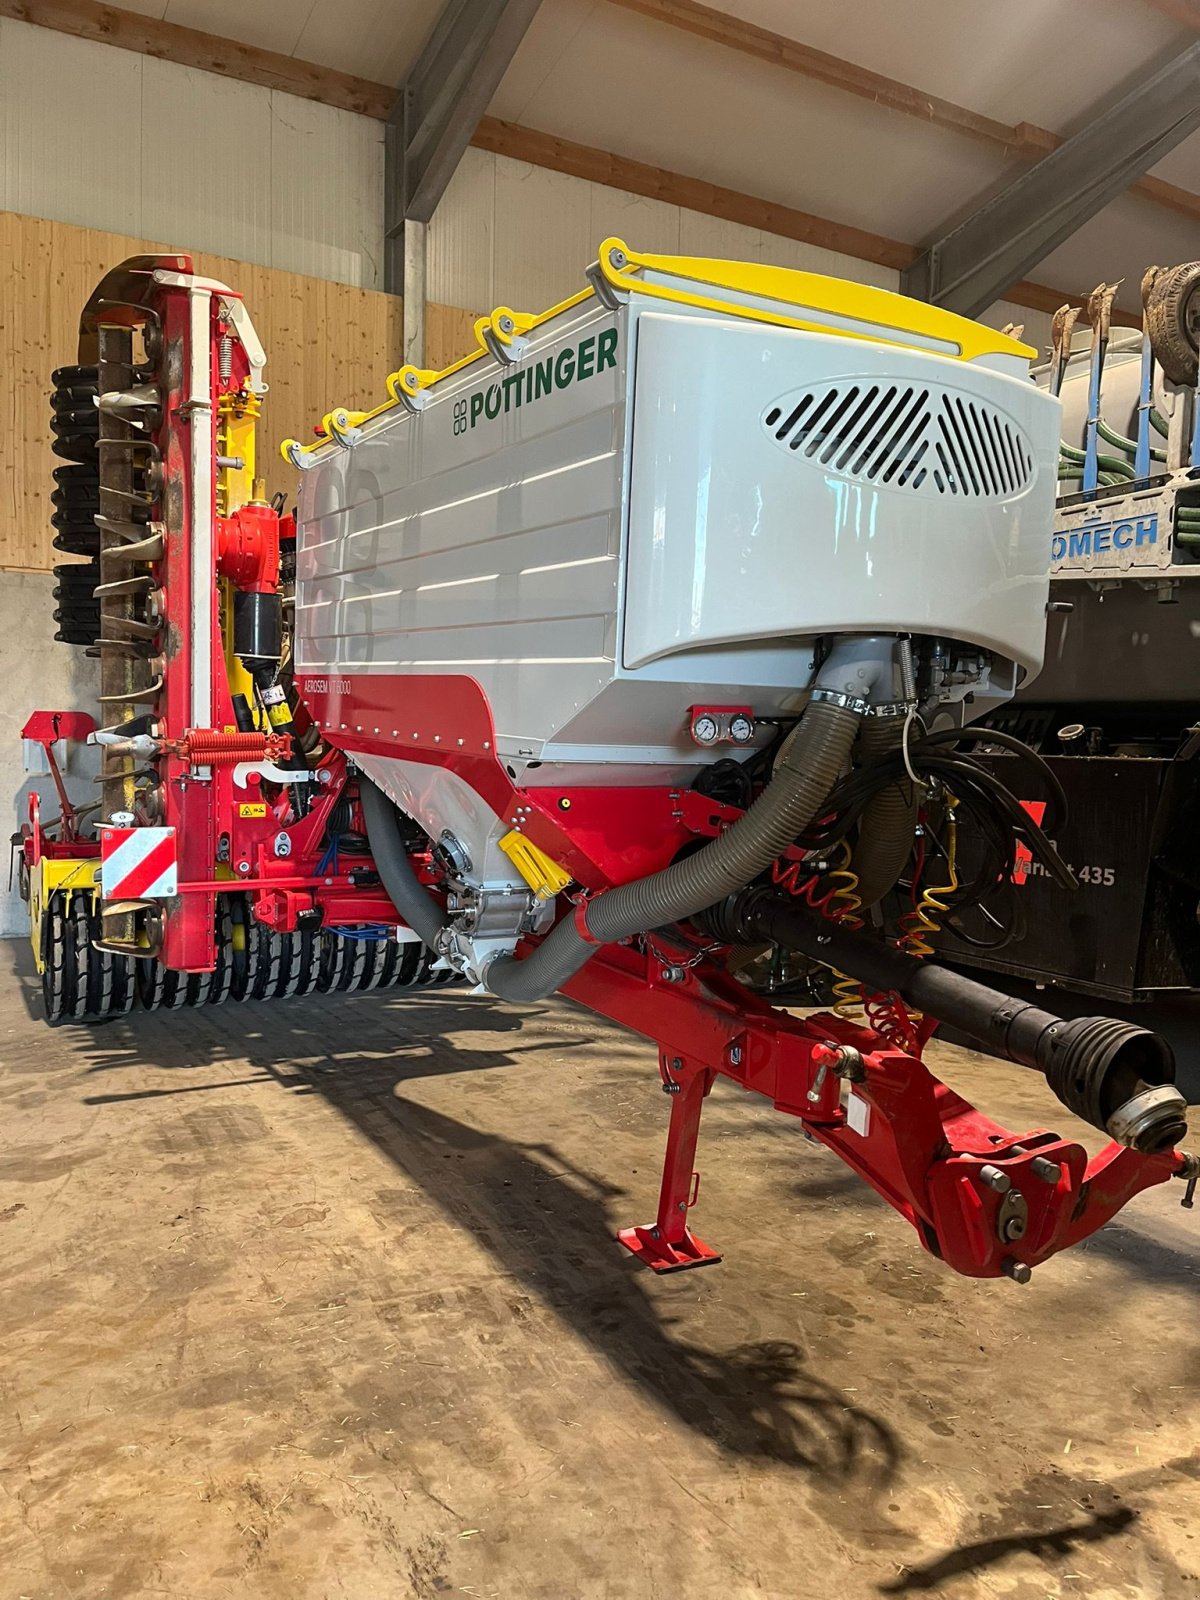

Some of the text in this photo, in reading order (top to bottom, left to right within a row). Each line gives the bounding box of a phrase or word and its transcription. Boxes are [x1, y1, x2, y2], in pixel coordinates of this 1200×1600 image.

[470, 327, 619, 429] PÖTTINGER
[1051, 518, 1159, 561] OMECH
[304, 679, 328, 694] AEROSEM
[1078, 865, 1116, 887] 435
